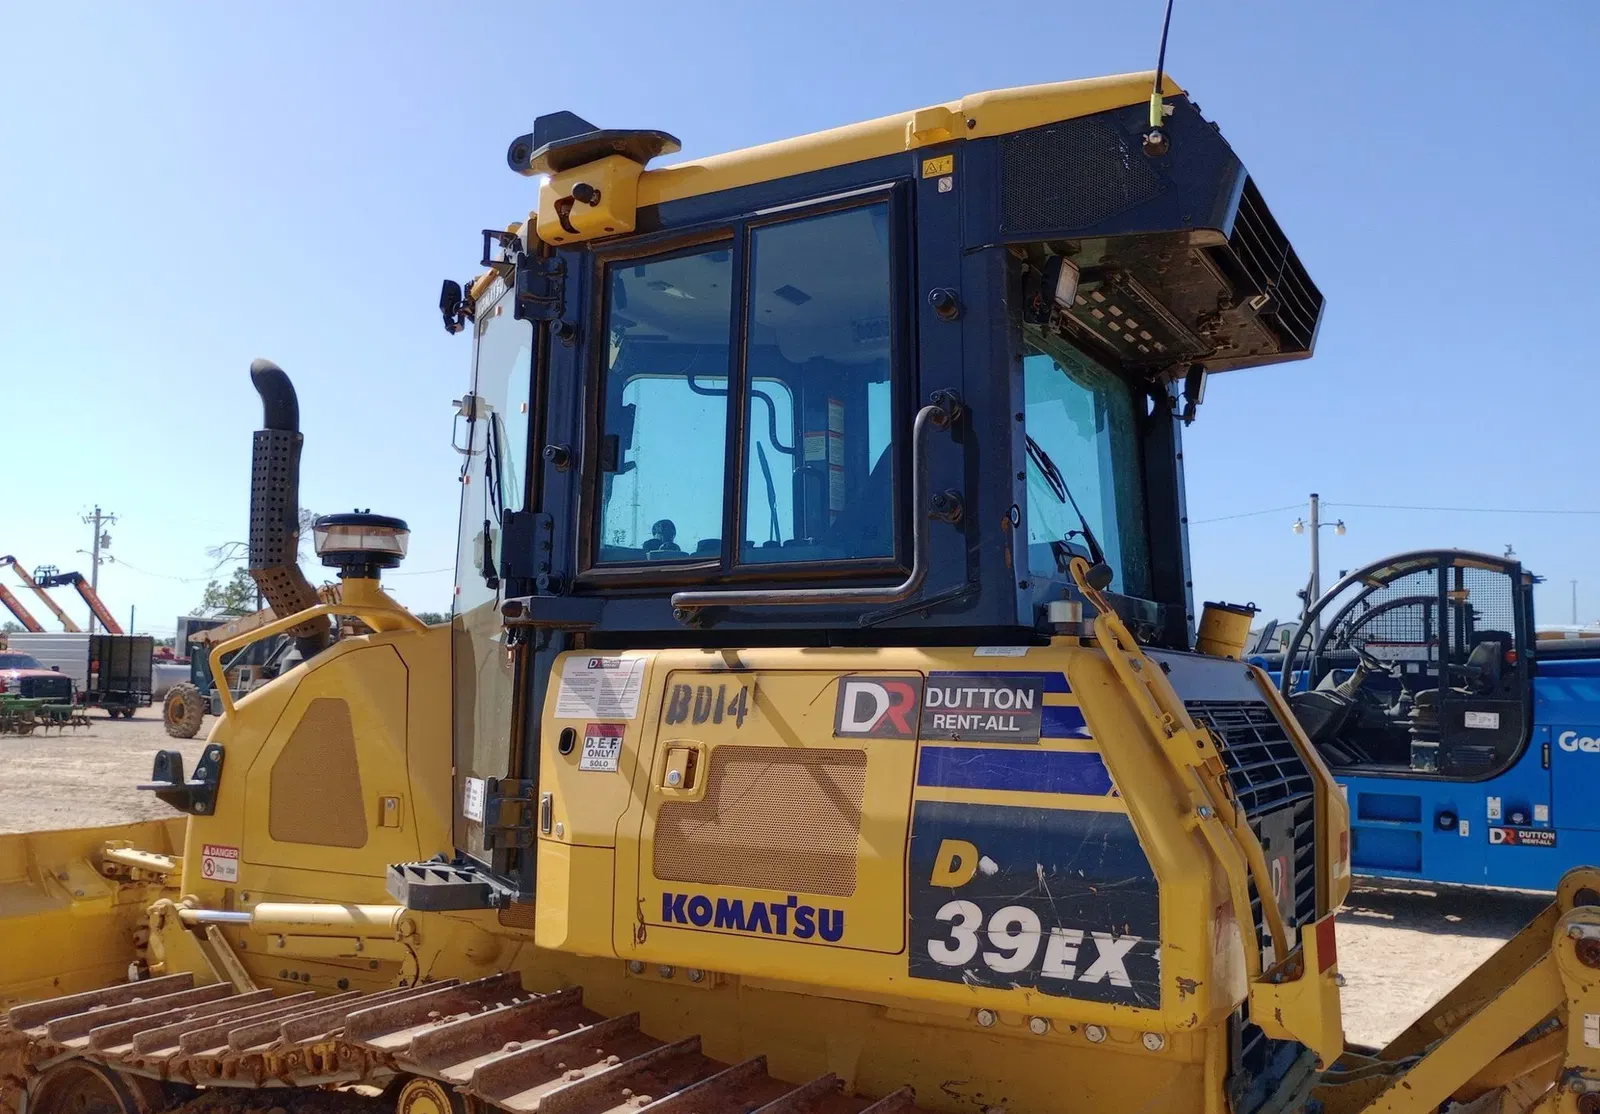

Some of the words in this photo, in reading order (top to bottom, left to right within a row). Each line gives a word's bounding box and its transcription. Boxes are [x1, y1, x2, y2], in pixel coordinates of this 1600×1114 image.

[925, 687, 1035, 710] DUTTON
[840, 681, 916, 734] DR
[932, 714, 1020, 731] RENT-ALL
[587, 749, 615, 758] ONLY!
[1518, 830, 1556, 840] DUTTON
[210, 847, 239, 859] DANGER
[661, 892, 844, 942] KOMATSU
